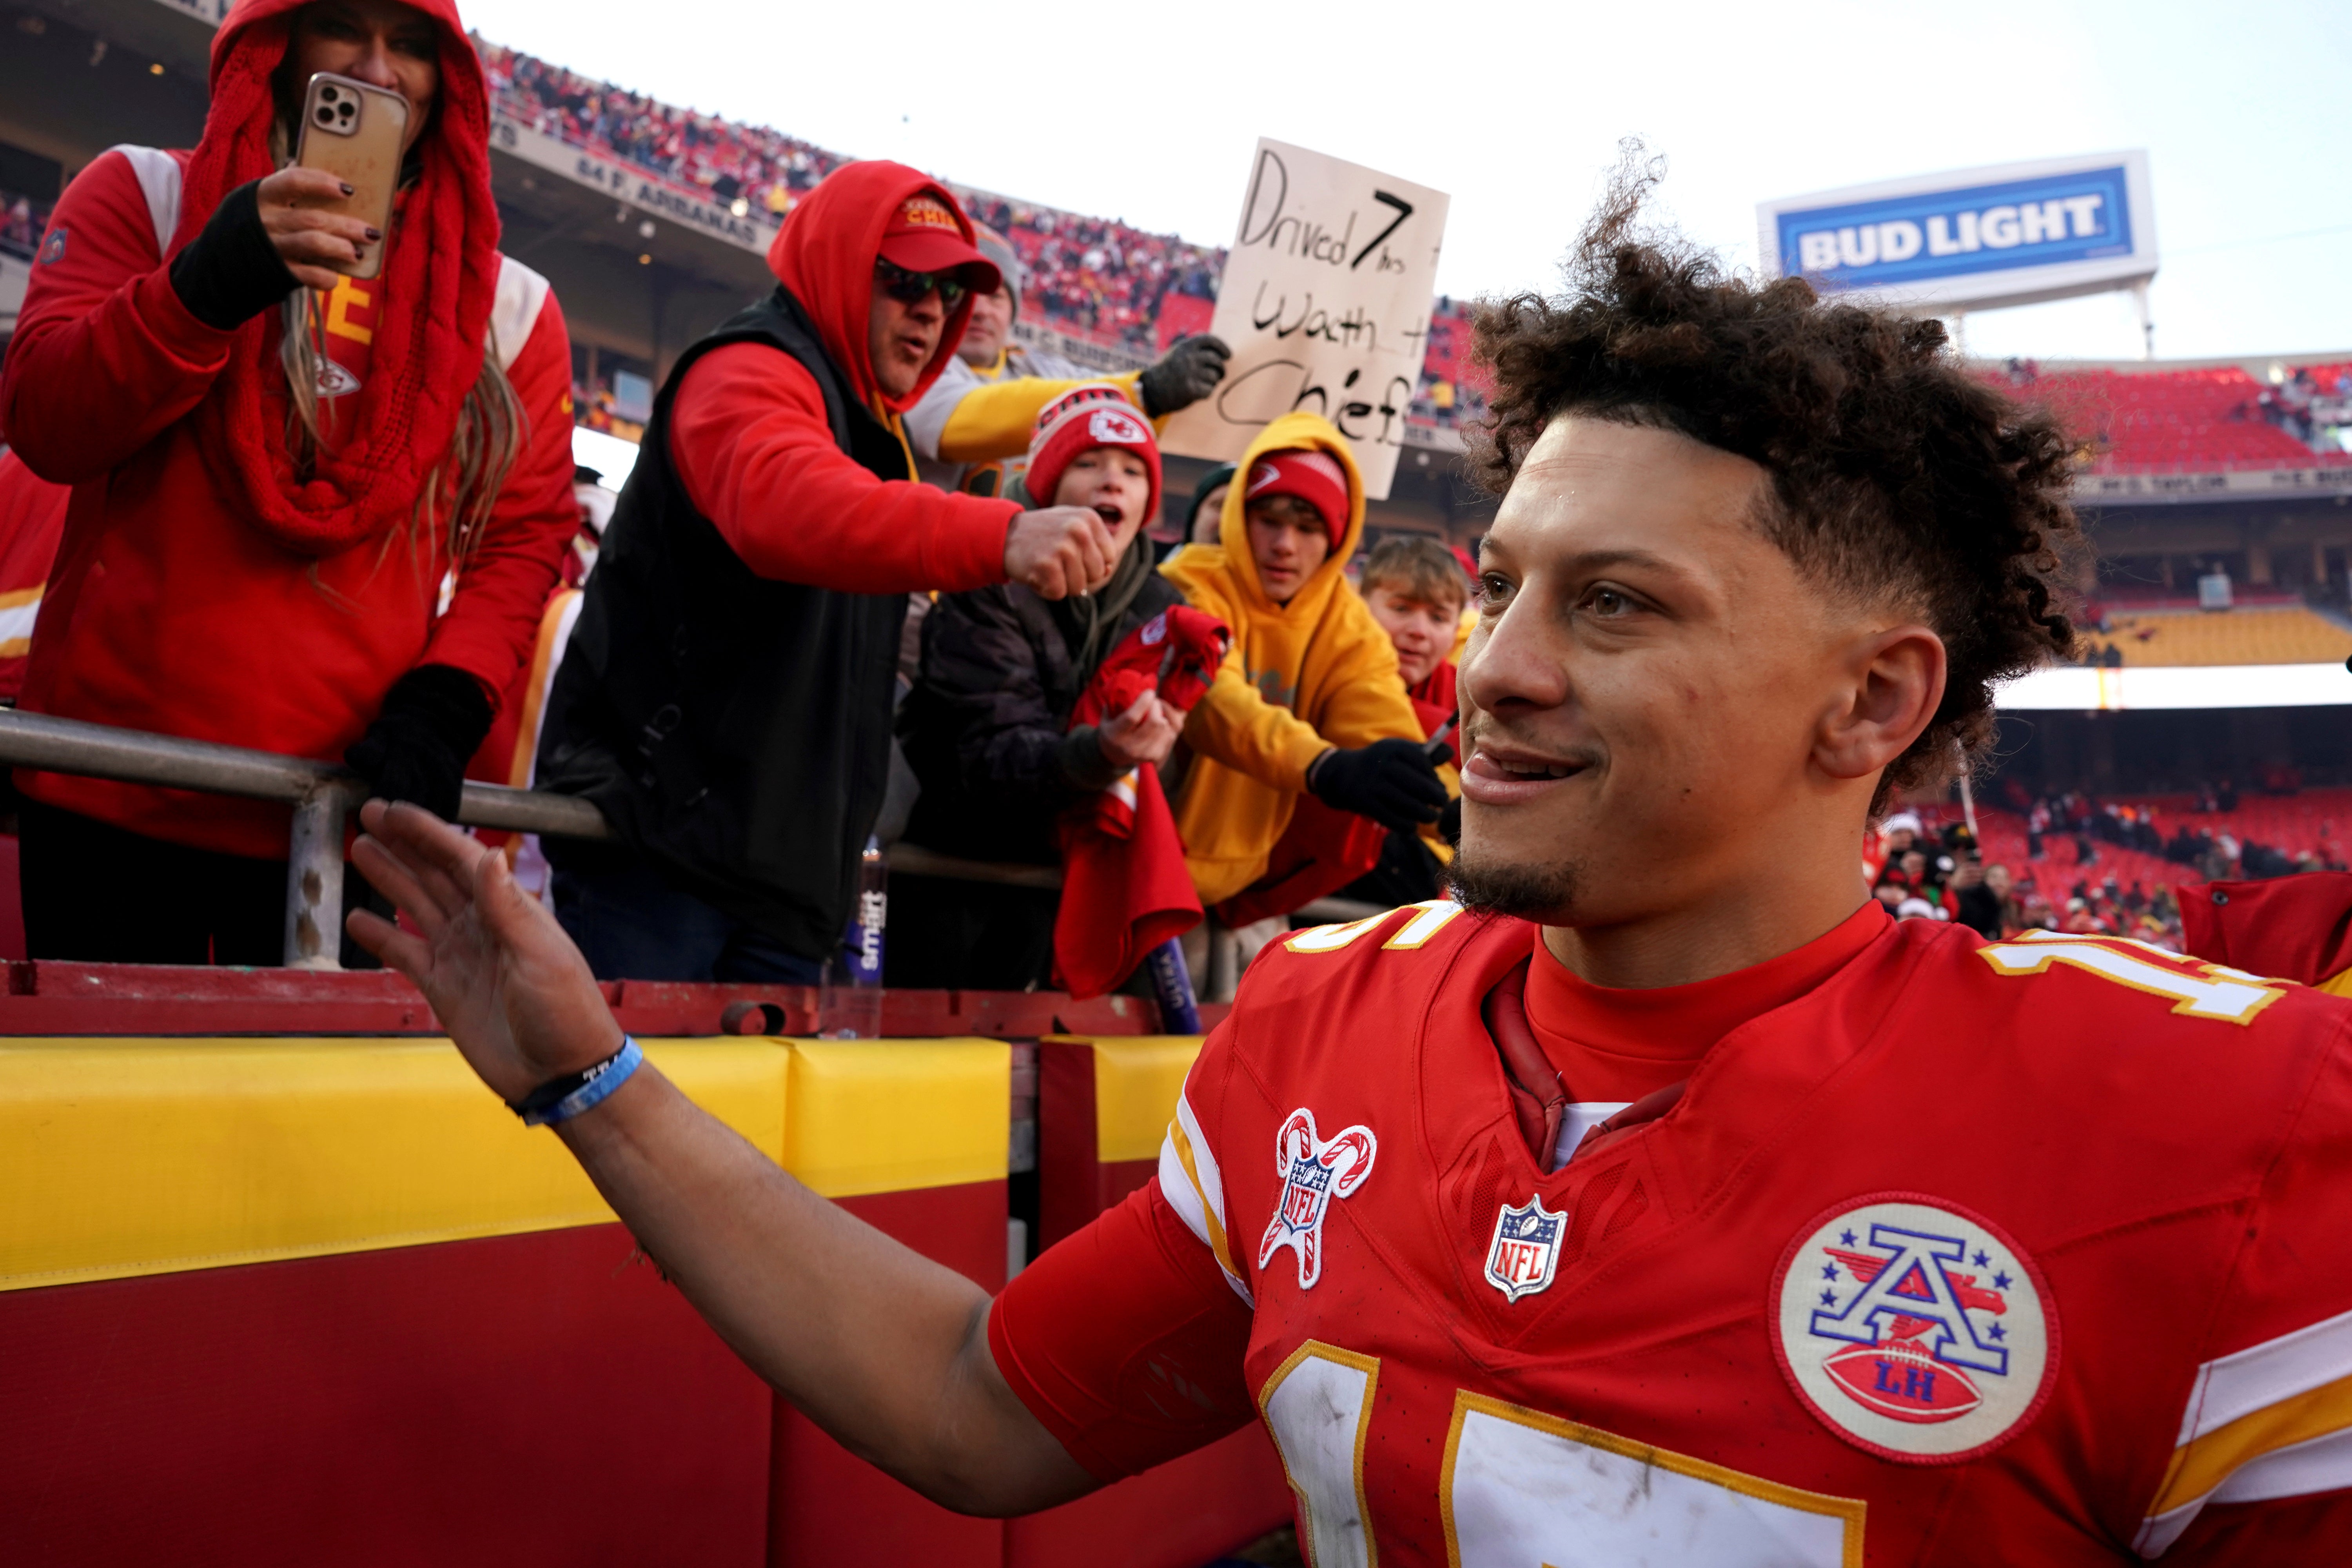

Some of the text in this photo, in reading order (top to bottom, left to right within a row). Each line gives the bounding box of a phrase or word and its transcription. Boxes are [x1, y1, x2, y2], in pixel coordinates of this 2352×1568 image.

[1240, 149, 1357, 266] Drived
[1350, 188, 1414, 272] 7
[1798, 193, 2103, 270] BUD LIGHT
[1284, 1184, 1316, 1227] NFL
[1495, 1241, 1542, 1283] NFL
[1874, 1360, 1936, 1402] LH
